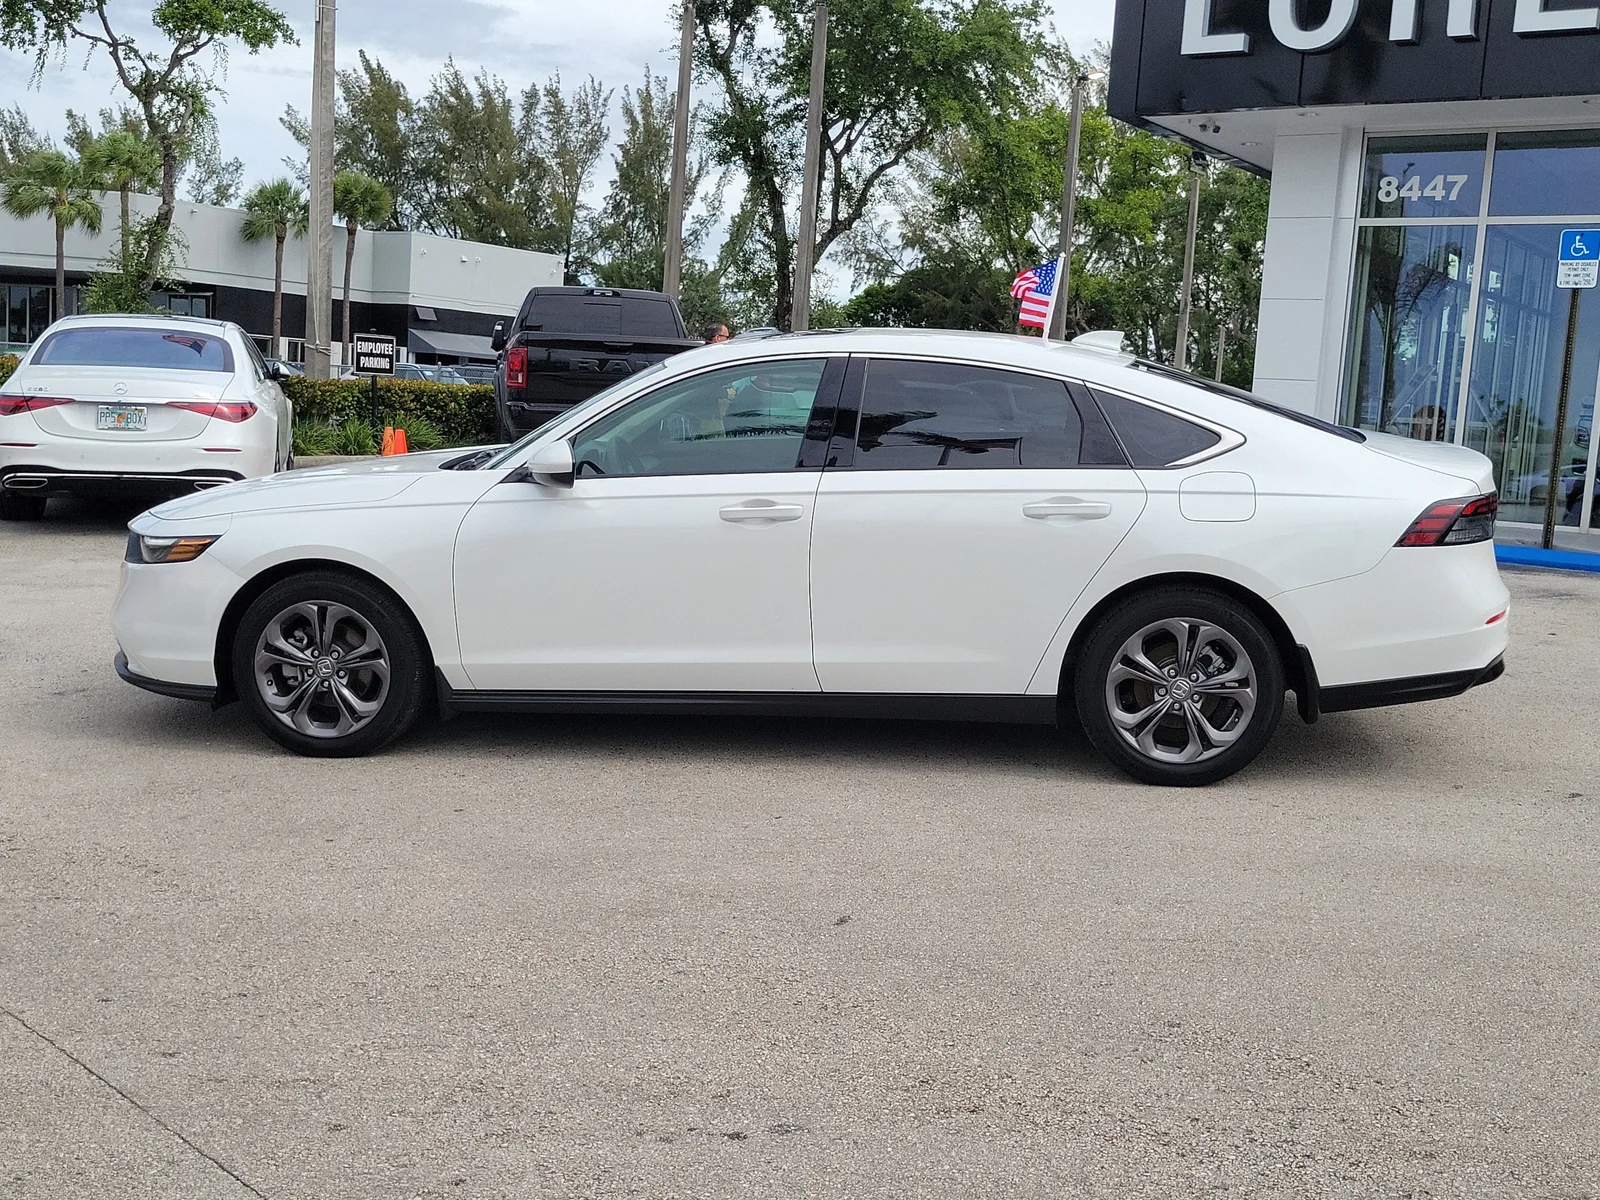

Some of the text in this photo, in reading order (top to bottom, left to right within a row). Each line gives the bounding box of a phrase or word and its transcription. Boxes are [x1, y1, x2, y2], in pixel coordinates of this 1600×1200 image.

[1378, 175, 1468, 203] 8447
[357, 341, 393, 355] EMPLOYEE
[360, 356, 390, 369] PARKING
